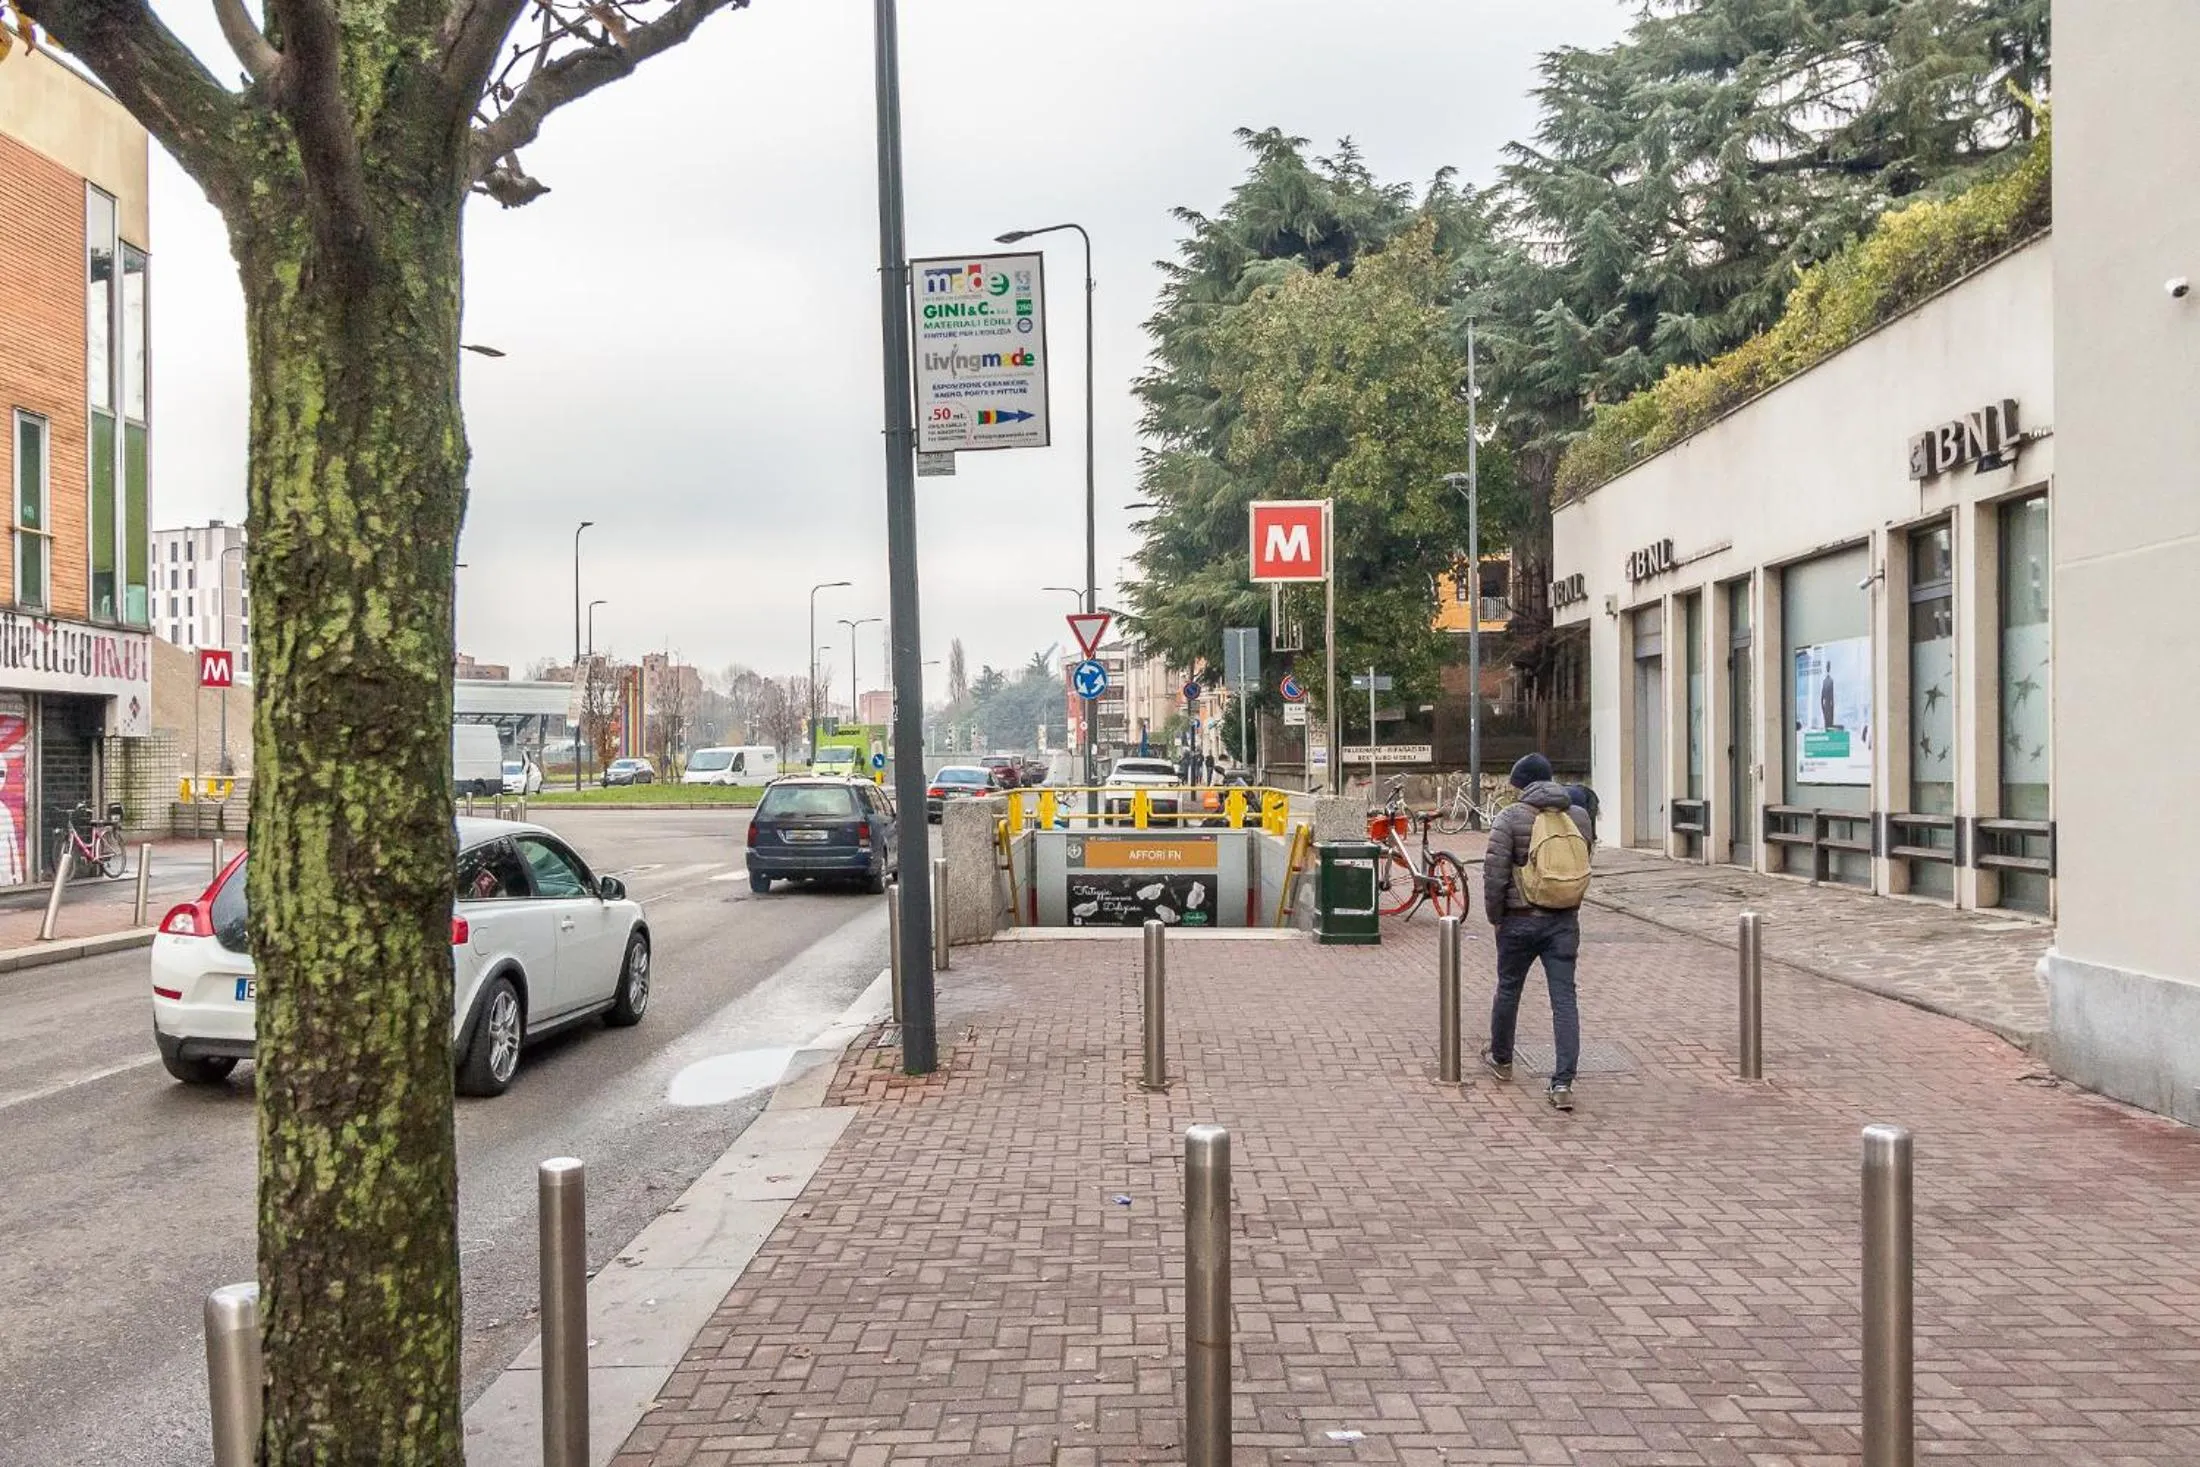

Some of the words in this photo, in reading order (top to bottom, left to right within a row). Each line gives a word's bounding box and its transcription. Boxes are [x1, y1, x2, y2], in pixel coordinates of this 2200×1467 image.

[923, 320, 980, 330] MATERIALI
[983, 317, 1013, 327] EDILI
[933, 408, 951, 421] 50
[1935, 398, 2020, 474] BNL
[1264, 524, 1311, 562] M
[1636, 538, 1673, 583] BNL
[1554, 573, 1587, 608] BNL
[203, 657, 230, 682] M
[1129, 850, 1166, 861] AFFORI
[1168, 850, 1182, 860] FN
